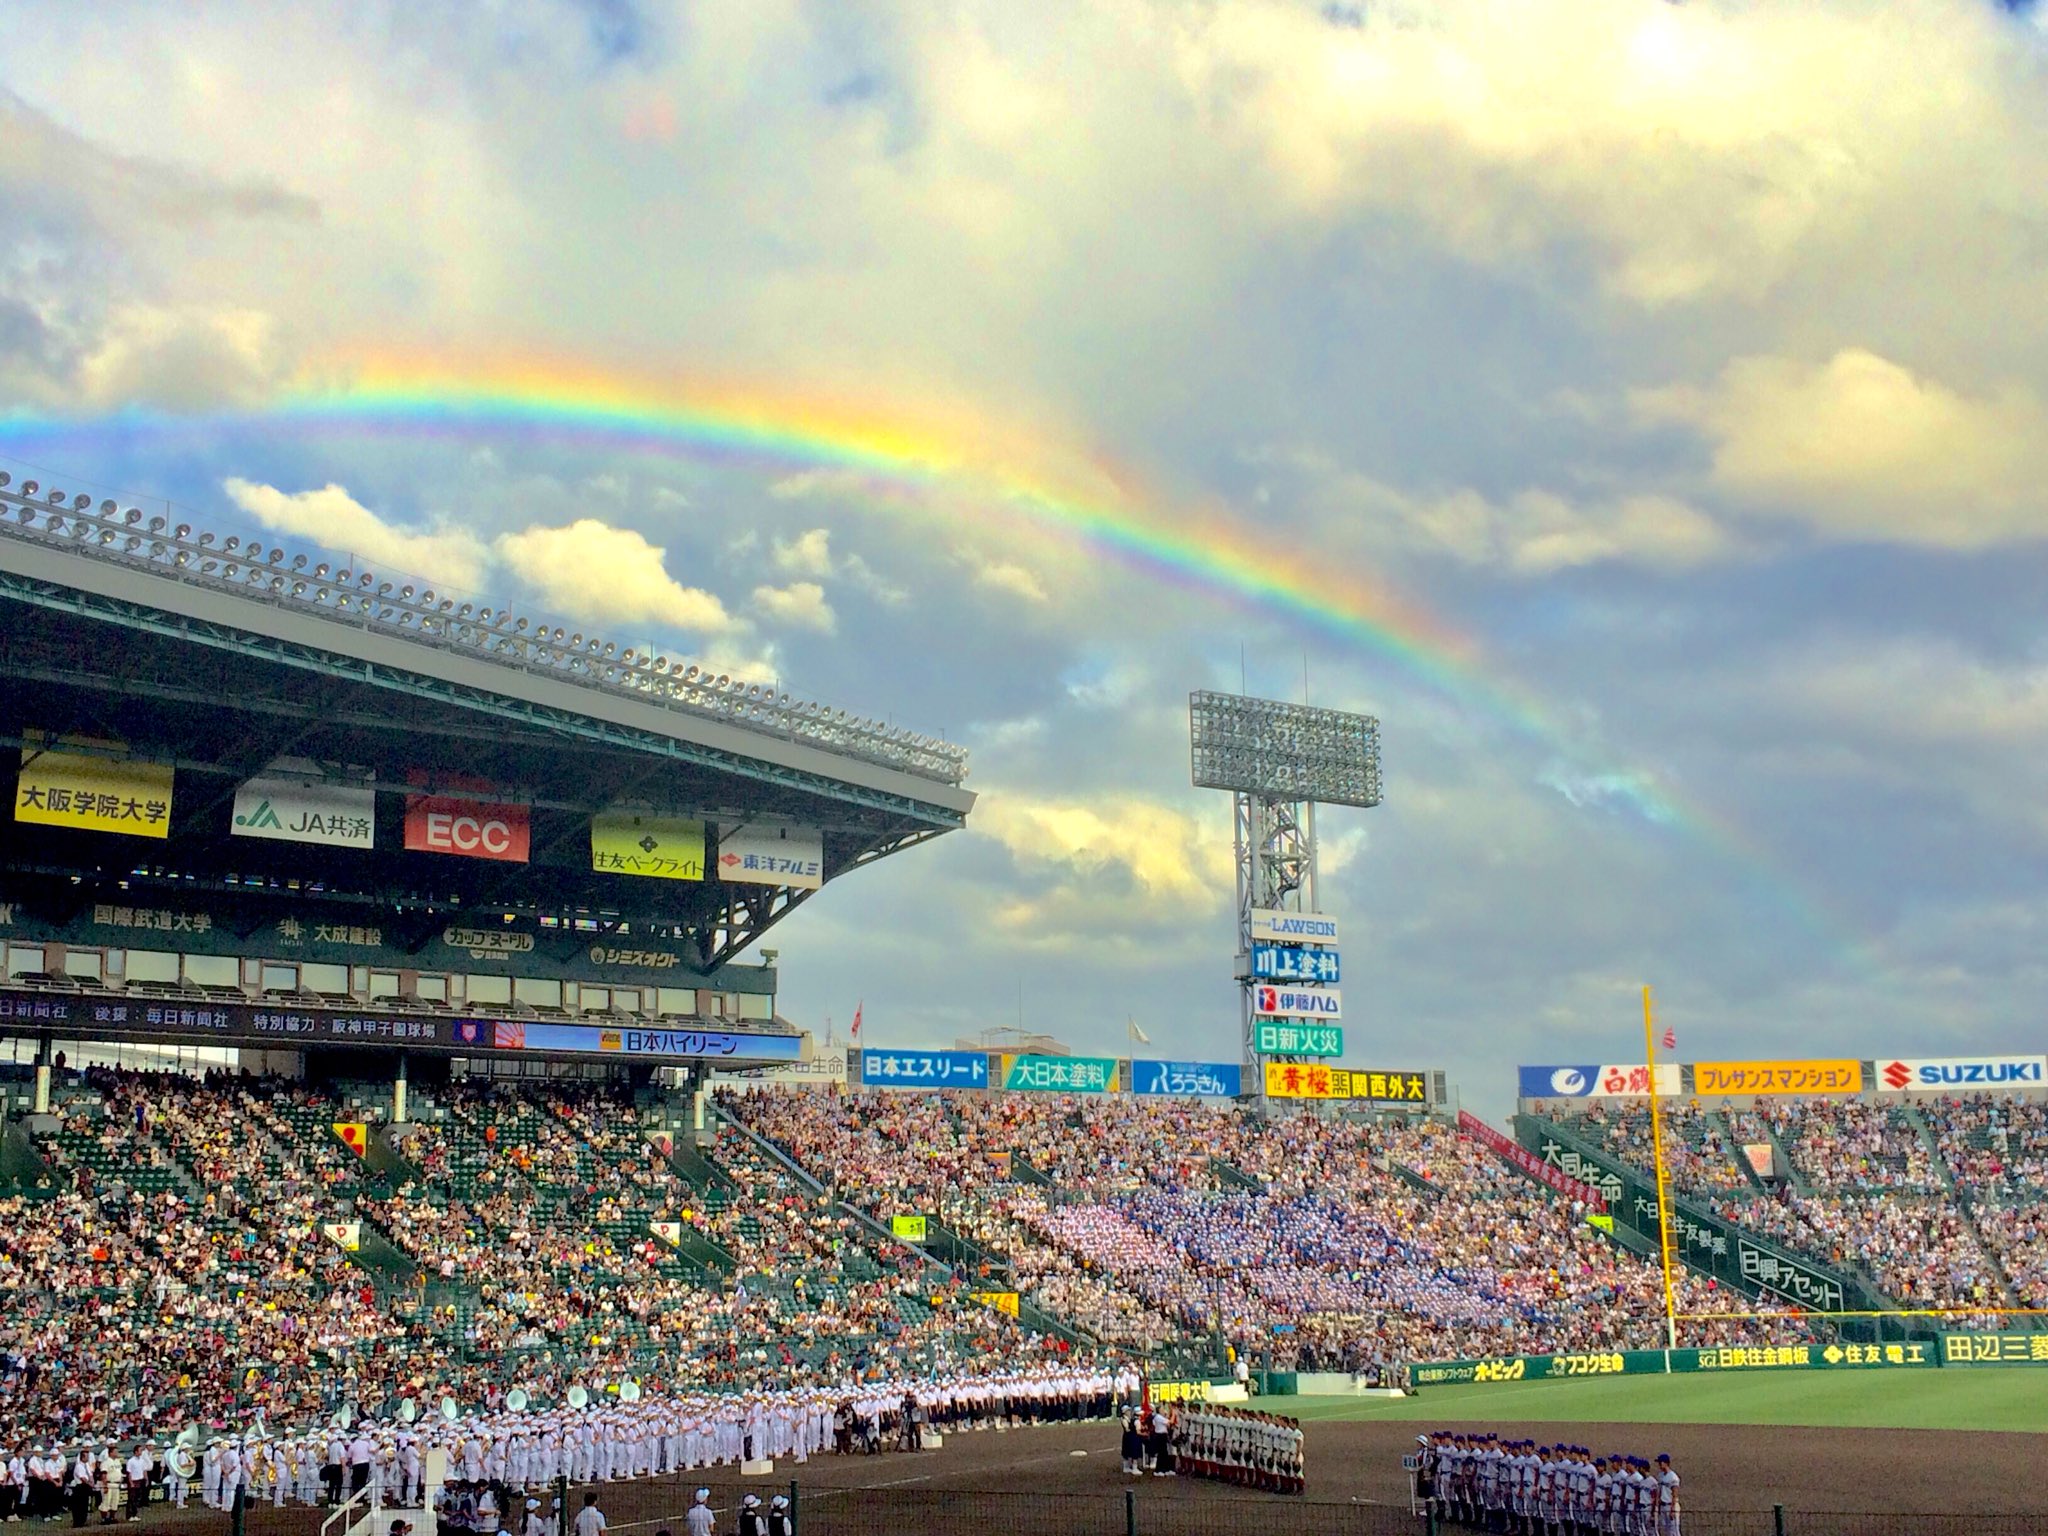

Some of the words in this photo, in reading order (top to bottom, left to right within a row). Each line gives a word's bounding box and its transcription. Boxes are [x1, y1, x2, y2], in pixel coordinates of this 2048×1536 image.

[20, 785, 167, 822] 大阪学院大学
[289, 812, 372, 840] JA共済
[427, 813, 510, 853] ECC
[594, 851, 704, 876] 住友ベークライト
[743, 853, 819, 877] 東洋アルミ
[94, 904, 211, 933] 国際武道大学
[1272, 917, 1336, 937] LAWSON
[315, 925, 381, 946] 大成建設
[450, 929, 530, 949] カップヌードル
[606, 949, 680, 968] シミズオクト
[1257, 949, 1338, 980] 川上塗料
[1280, 993, 1339, 1013] 伊藤ハム
[1261, 1027, 1338, 1052] 日新火災
[866, 1056, 986, 1080] 日本エスリード
[1016, 1060, 1105, 1088] 大日本塗料
[1702, 1068, 1853, 1089] プレサンスマンション
[1918, 1062, 2042, 1084] SUZUKI
[1171, 1073, 1226, 1094] ろうきん
[1282, 1067, 1330, 1095] 黄桜
[1352, 1072, 1424, 1099] 関西外大
[1541, 1139, 1622, 1201] 大同生命
[1742, 1251, 1840, 1309] 日興アセット
[1567, 1352, 1624, 1374] フコク生命
[1845, 1345, 1925, 1363] 住友電工
